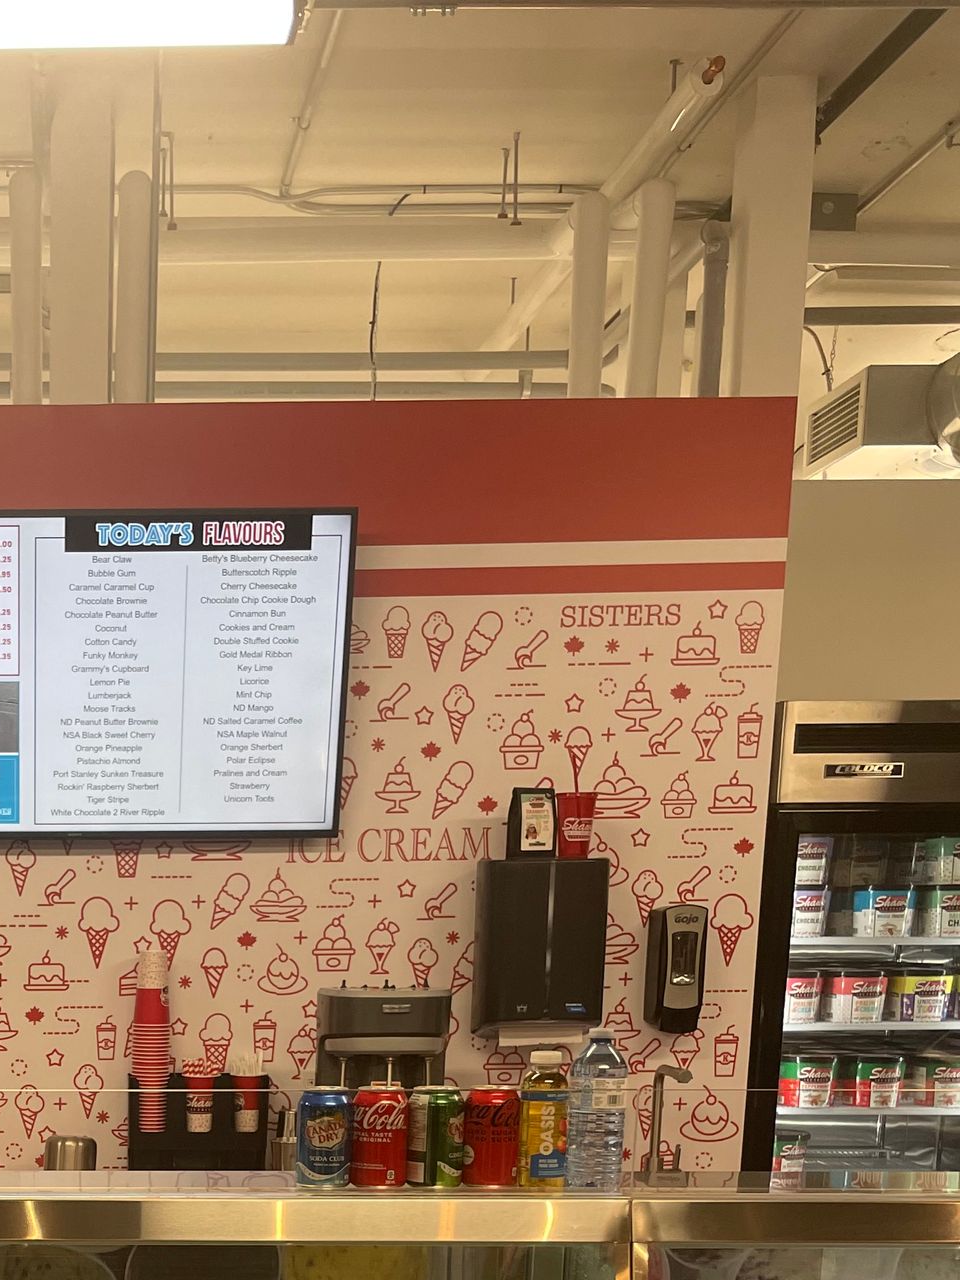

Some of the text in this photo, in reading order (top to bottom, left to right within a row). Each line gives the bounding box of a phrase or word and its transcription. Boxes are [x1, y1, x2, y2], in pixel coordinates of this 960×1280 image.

[96, 521, 285, 546] TODAY'S FLAVOURS
[92, 556, 132, 564] Bear Claw
[202, 554, 318, 564] Betty's Blueberry Cheesecake
[88, 570, 136, 578] Bubble Gum
[222, 568, 297, 577] Butterscotch Ripple
[138, 583, 154, 592] Cup
[220, 582, 297, 591] Cherry Cheesecake
[200, 596, 316, 605] Chocolate Chip Cookie Dough
[560, 604, 681, 628] SISTERS
[94, 624, 127, 632] Coconut
[84, 638, 137, 647] Cotton Candy
[82, 652, 138, 660] Funky Monkey
[71, 665, 150, 674] Grammy's Cupboard
[237, 664, 252, 673] Key
[88, 692, 131, 700] Lumberjack
[835, 763, 895, 775] COLDCO
[286, 827, 491, 864] ICE CREAM
[540, 1103, 555, 1155] OASIS
[318, 1131, 339, 1144] DRY
